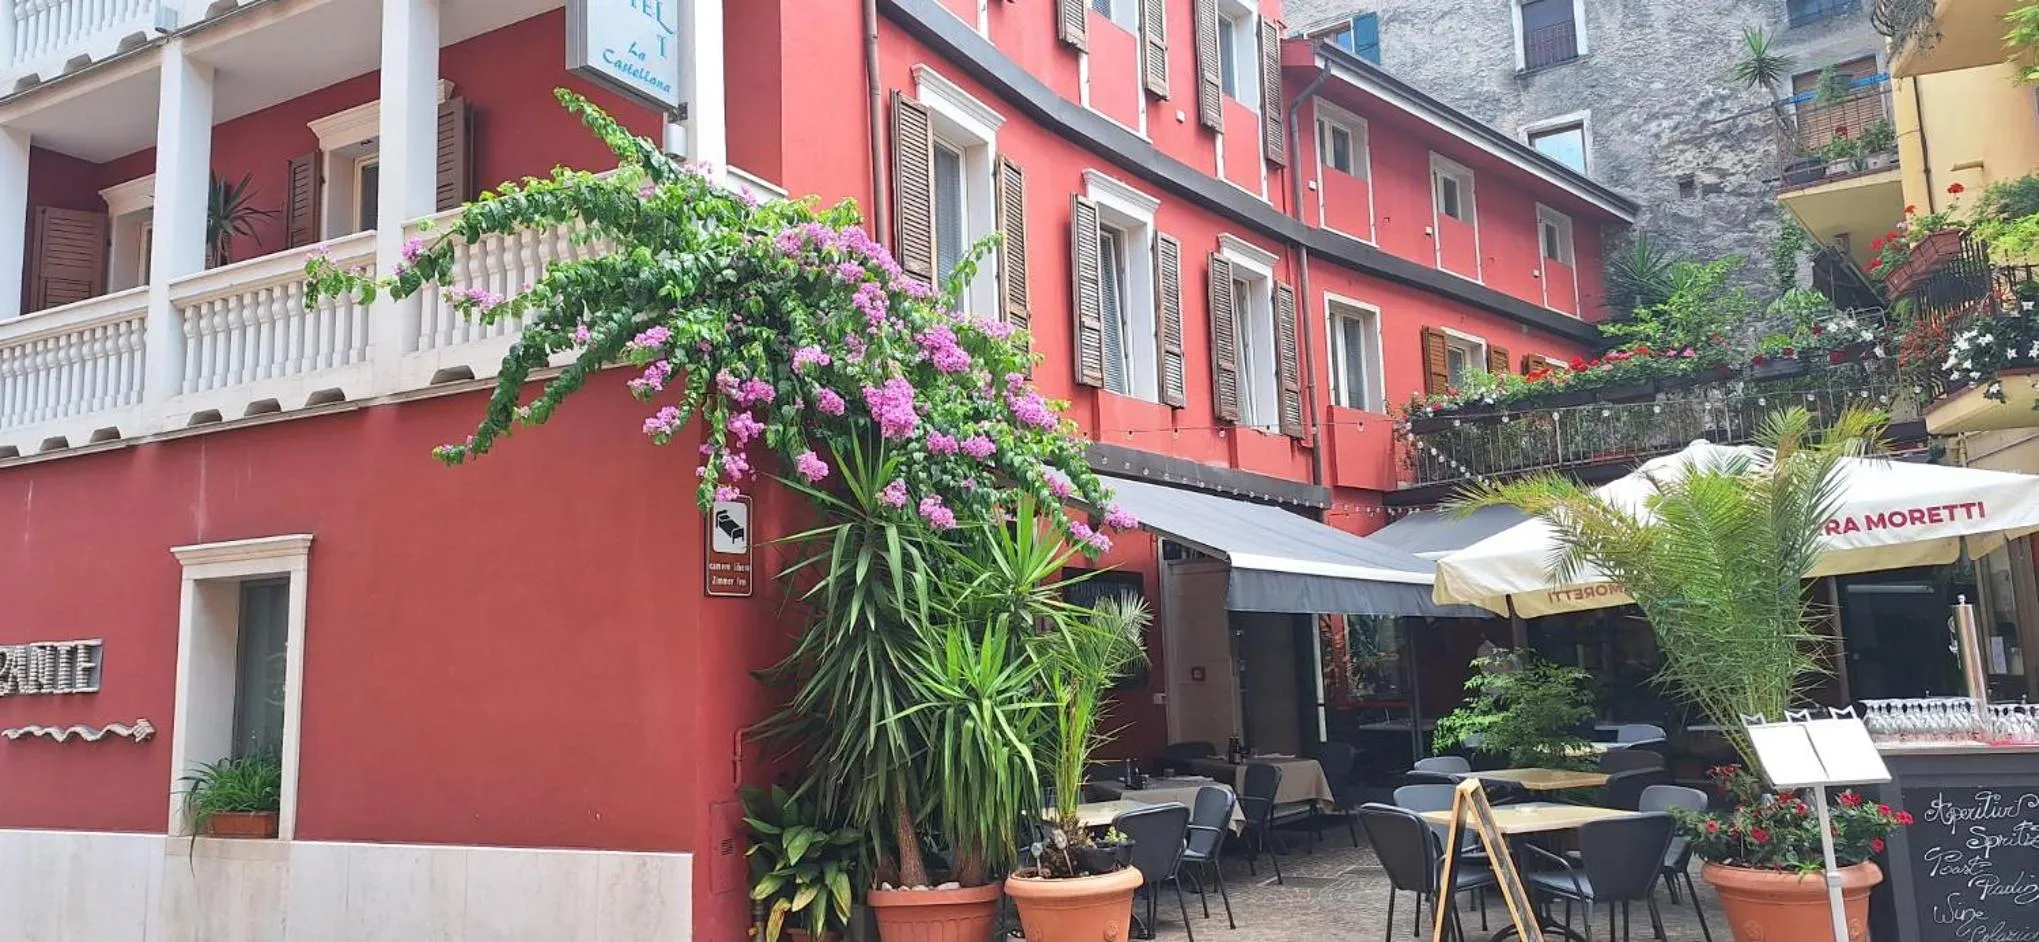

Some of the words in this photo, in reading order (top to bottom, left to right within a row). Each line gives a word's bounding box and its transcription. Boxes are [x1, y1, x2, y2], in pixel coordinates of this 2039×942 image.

[628, 41, 646, 61] La
[602, 48, 672, 94] Castellana
[1864, 500, 1986, 531] MORETTI
[1932, 892, 1989, 938] Wine
